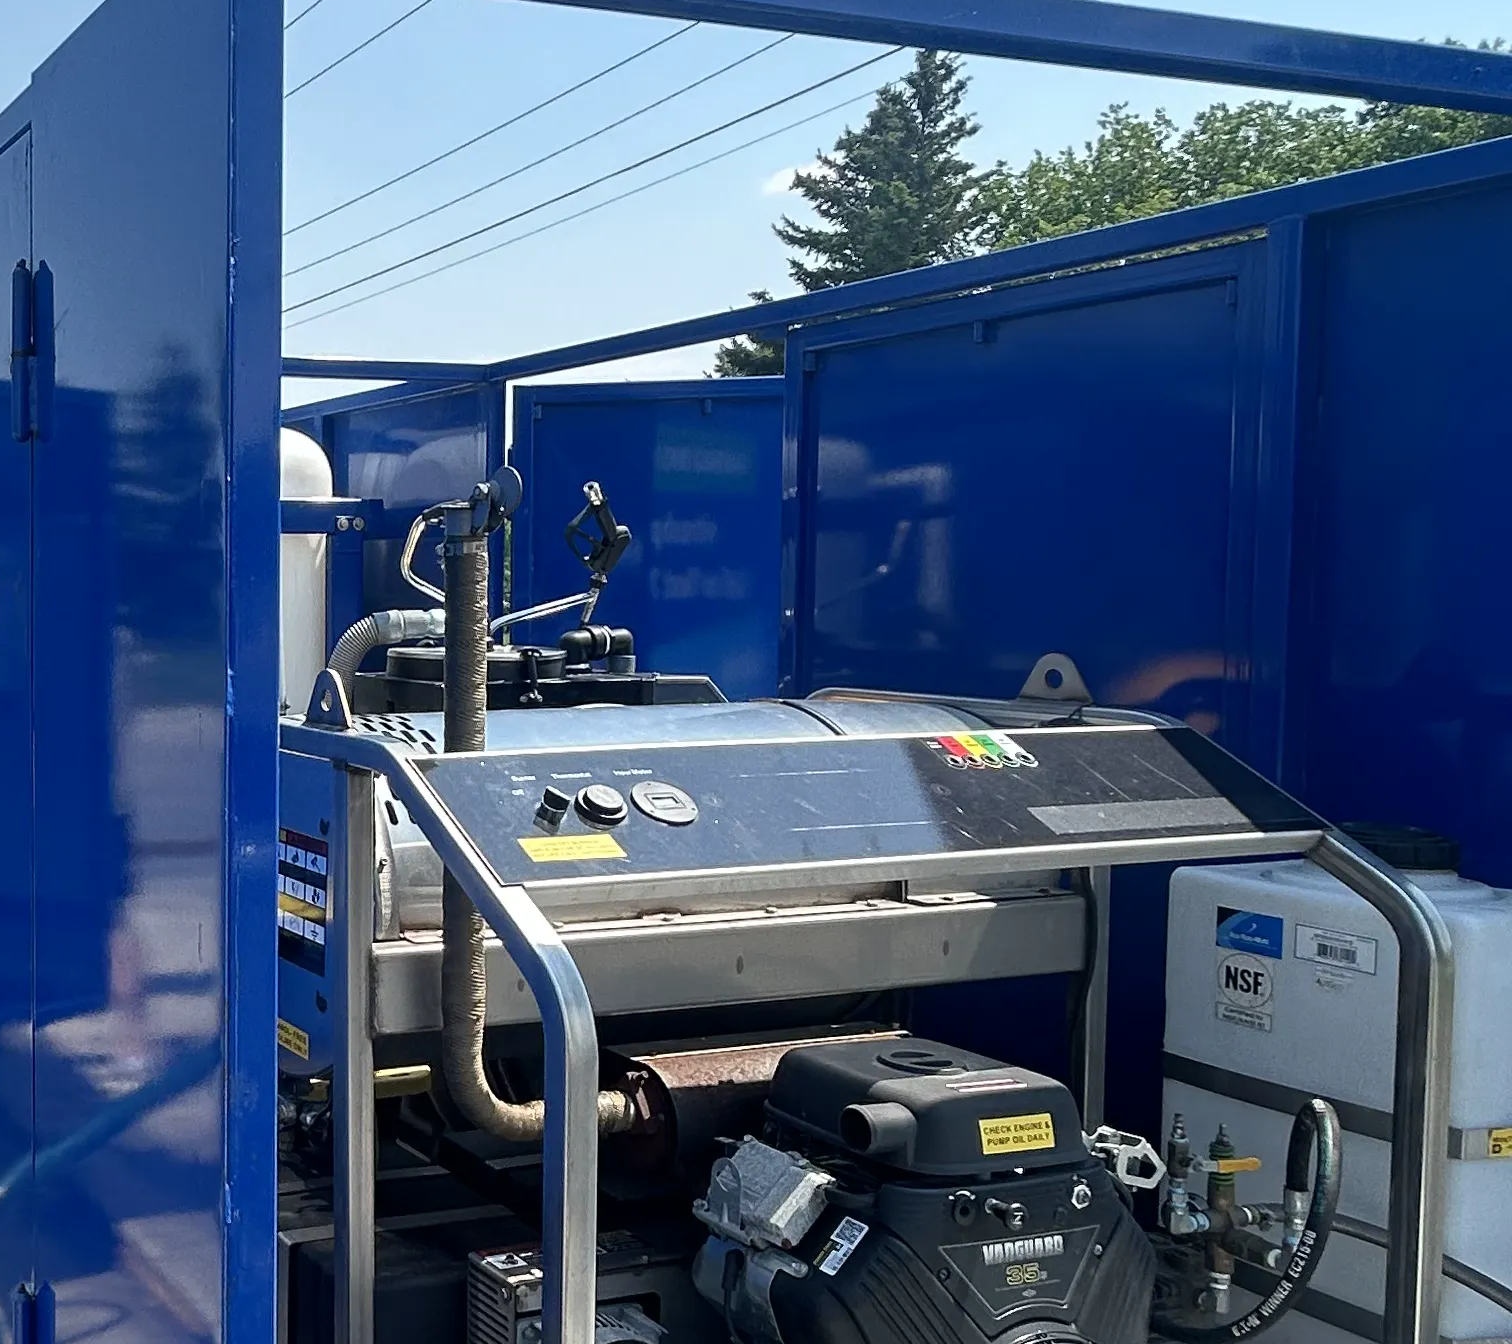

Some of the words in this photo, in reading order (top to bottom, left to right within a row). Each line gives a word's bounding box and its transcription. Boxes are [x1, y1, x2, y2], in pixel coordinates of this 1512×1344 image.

[1224, 964, 1265, 996] NSF
[982, 1126, 1012, 1136] CHECK
[1013, 1121, 1043, 1132] ENGINE
[986, 1136, 1011, 1147] PUMP
[1012, 1135, 1026, 1144] OIL
[1026, 1132, 1050, 1143] DAILY
[982, 1234, 1065, 1266] VANGUARD
[1005, 1261, 1040, 1286] 35
[1258, 1280, 1294, 1318] WINNER
